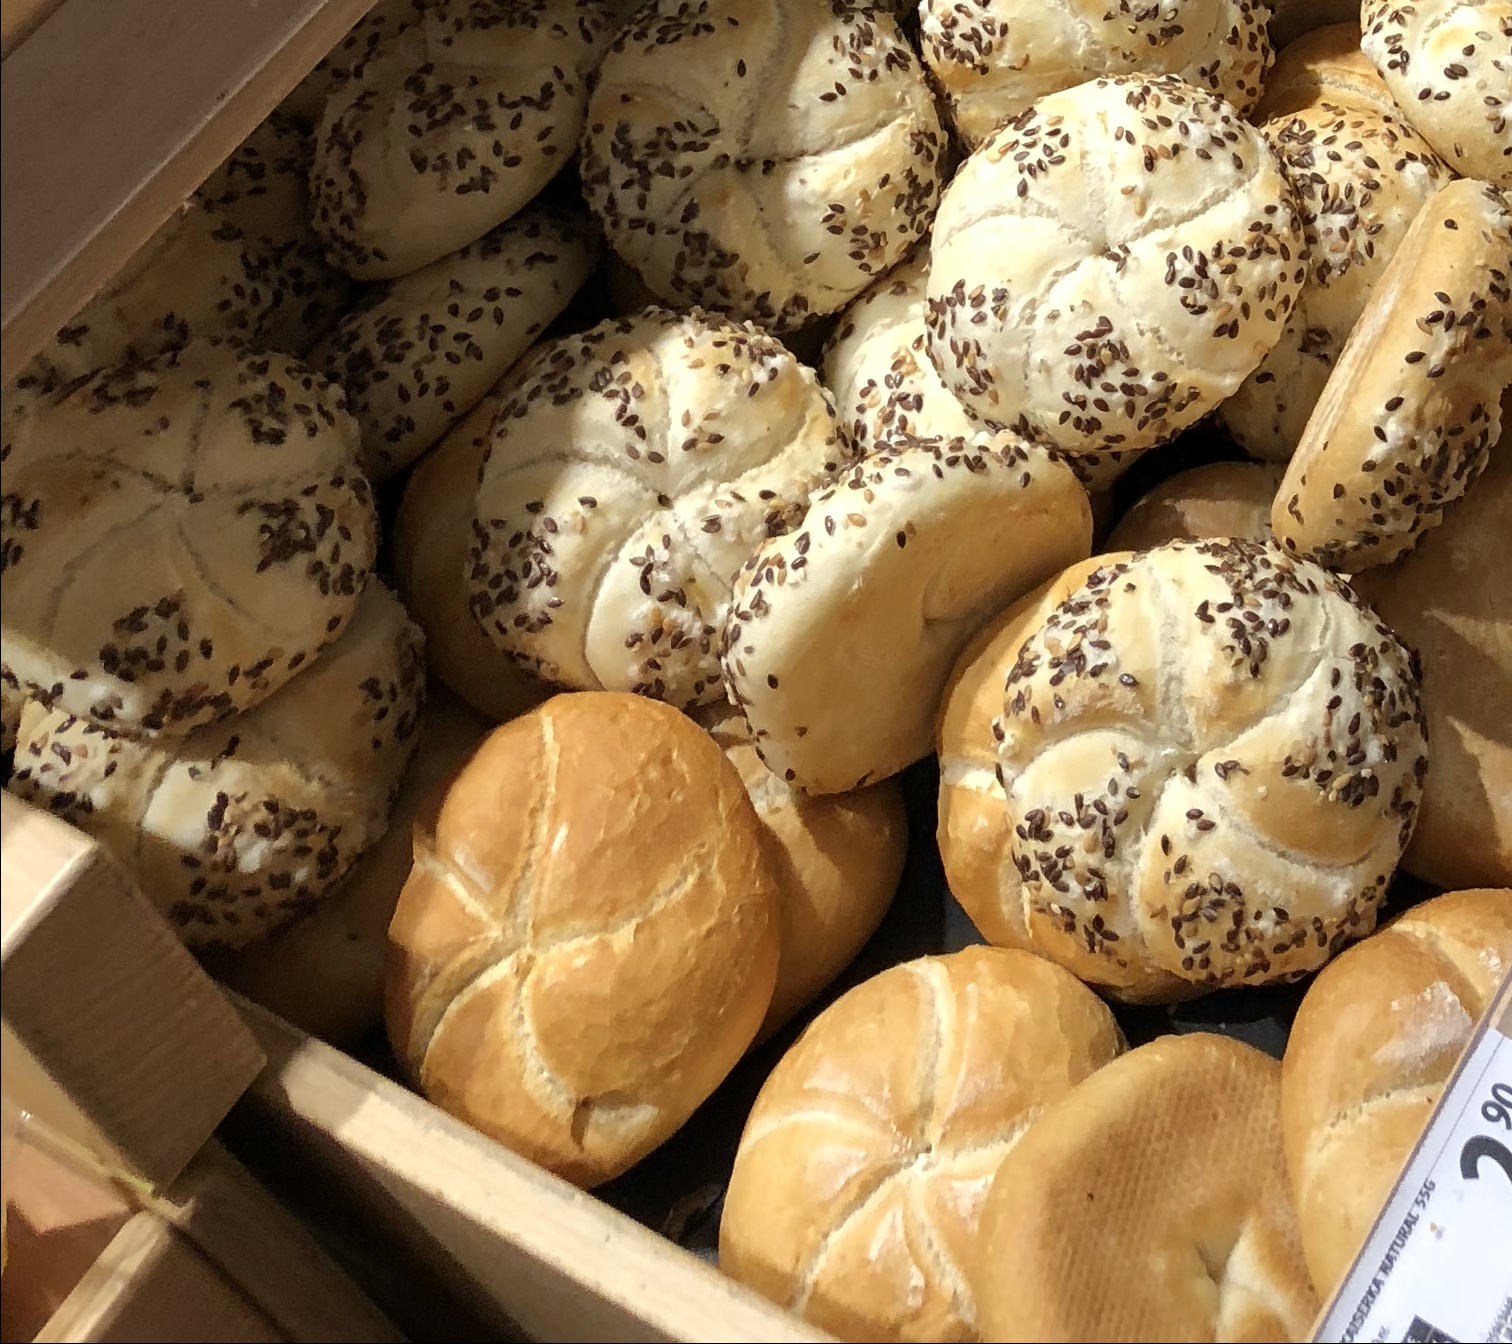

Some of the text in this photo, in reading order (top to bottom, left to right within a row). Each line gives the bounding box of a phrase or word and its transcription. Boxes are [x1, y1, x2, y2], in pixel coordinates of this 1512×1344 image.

[1341, 1177, 1436, 1343] KAISERKA NATURAL 55G
